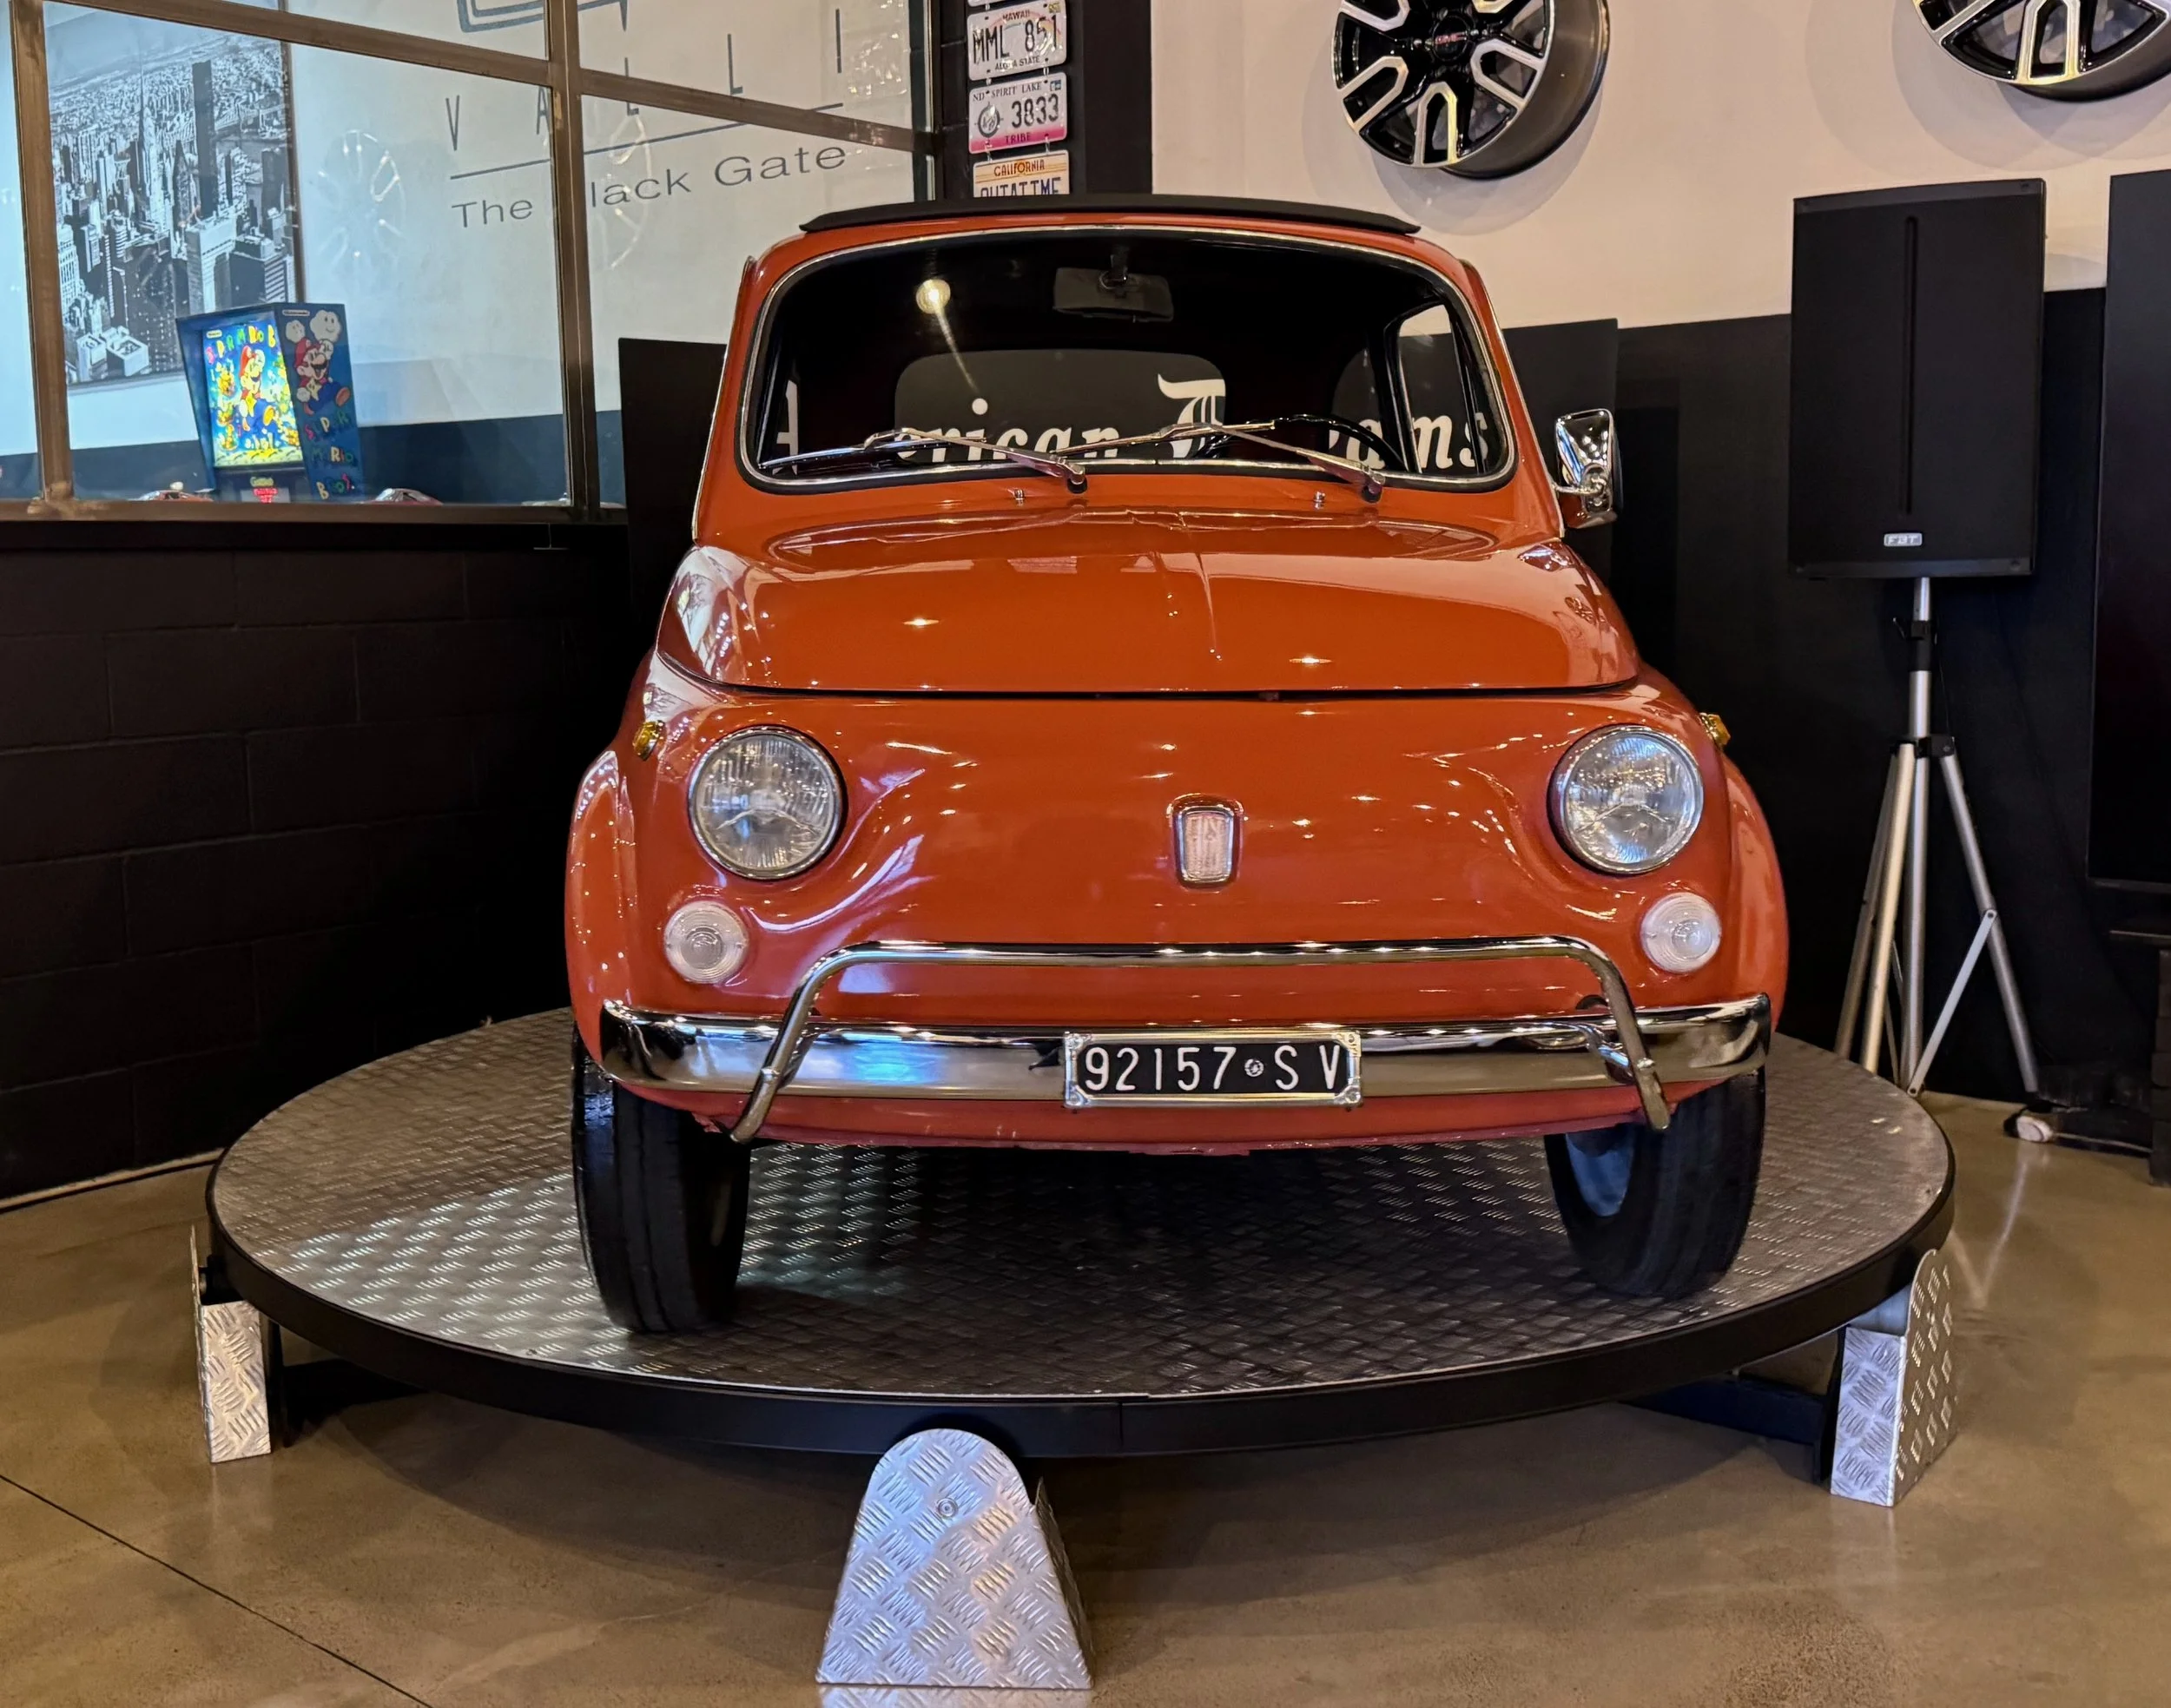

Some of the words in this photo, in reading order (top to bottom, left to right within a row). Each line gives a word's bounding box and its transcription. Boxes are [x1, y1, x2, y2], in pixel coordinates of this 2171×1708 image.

[973, 25, 1010, 64] MML
[1025, 15, 1057, 52] 851
[995, 60, 1018, 70] ALOA
[1019, 56, 1040, 67] STATE
[973, 93, 985, 102] ND
[992, 86, 1017, 98] SPIRIT
[1021, 82, 1042, 93] LAKE
[1012, 93, 1059, 129] 3833
[1005, 132, 1031, 144] TRIBE
[994, 159, 1045, 177] CALIFORNIA
[452, 199, 533, 228] The
[591, 168, 691, 208] lack
[714, 147, 846, 186] Gate
[1086, 1045, 1237, 1091] 92157
